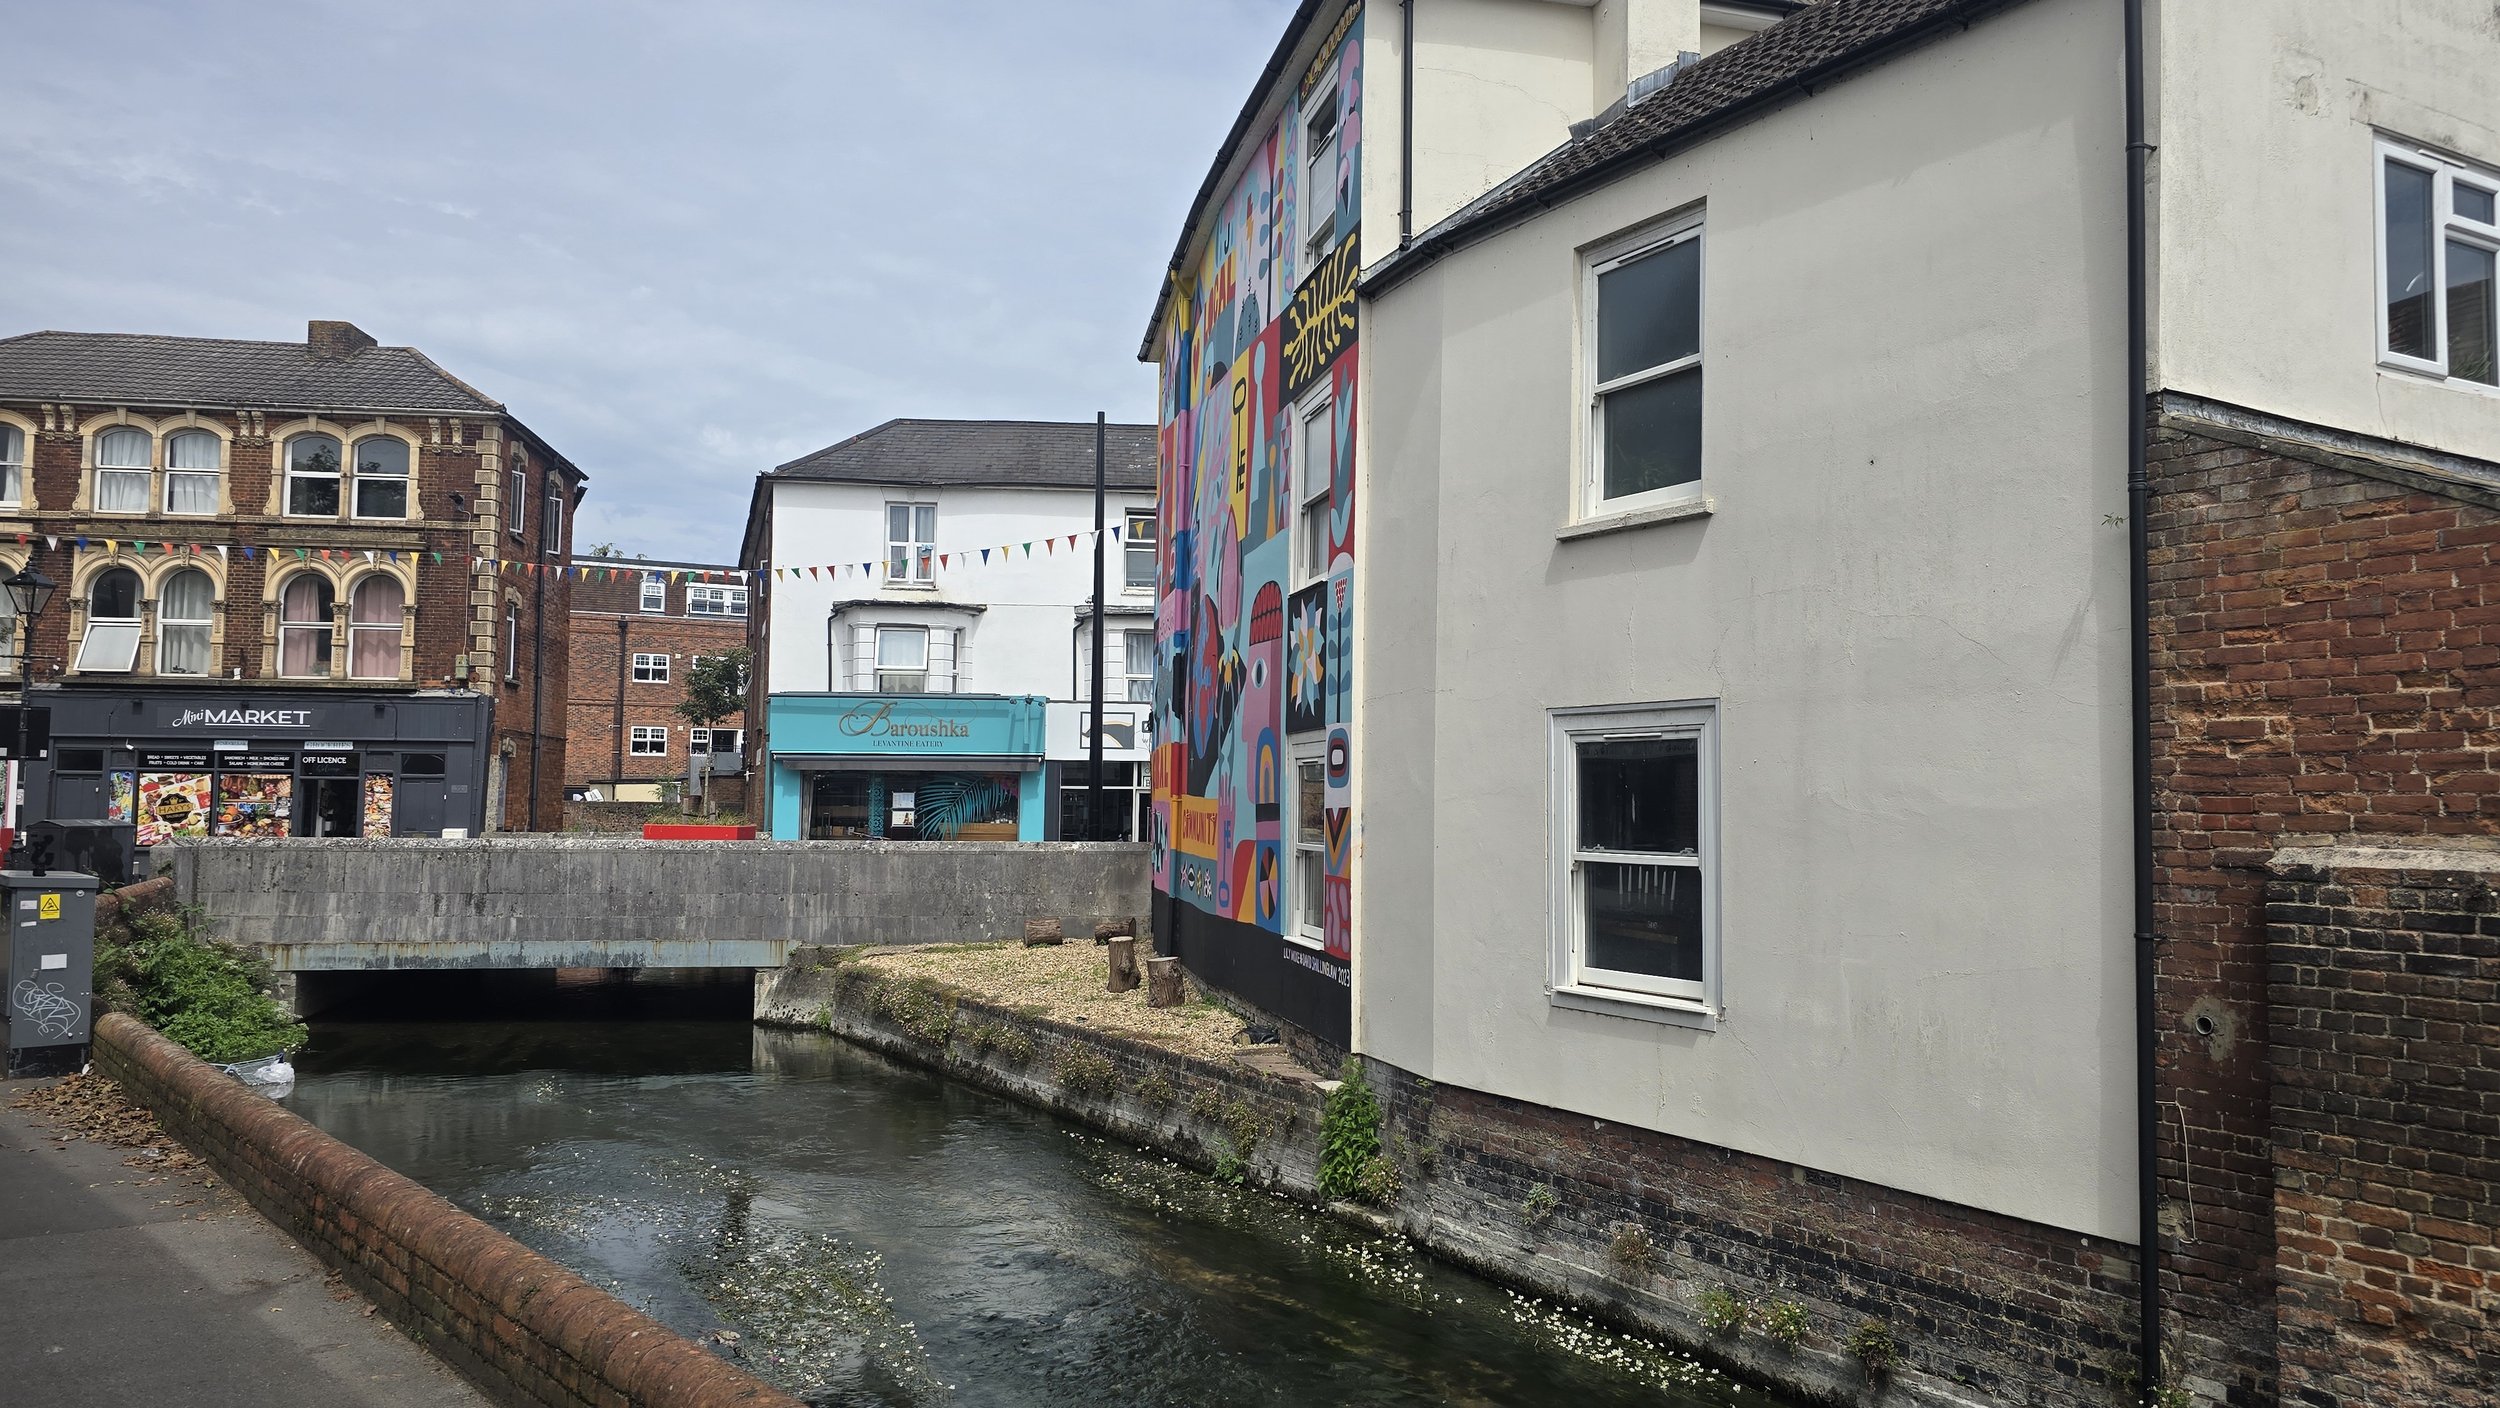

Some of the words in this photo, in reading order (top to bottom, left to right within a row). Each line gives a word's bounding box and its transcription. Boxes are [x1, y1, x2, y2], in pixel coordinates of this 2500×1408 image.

[1203, 252, 1235, 347] LOCAL
[172, 709, 204, 727] Mini
[205, 709, 311, 724] MARKET
[839, 701, 969, 737] Baroushka
[158, 804, 192, 813] HAKY'S
[1183, 809, 1217, 845] COMMUNITY
[1338, 966, 1350, 987] 2023
